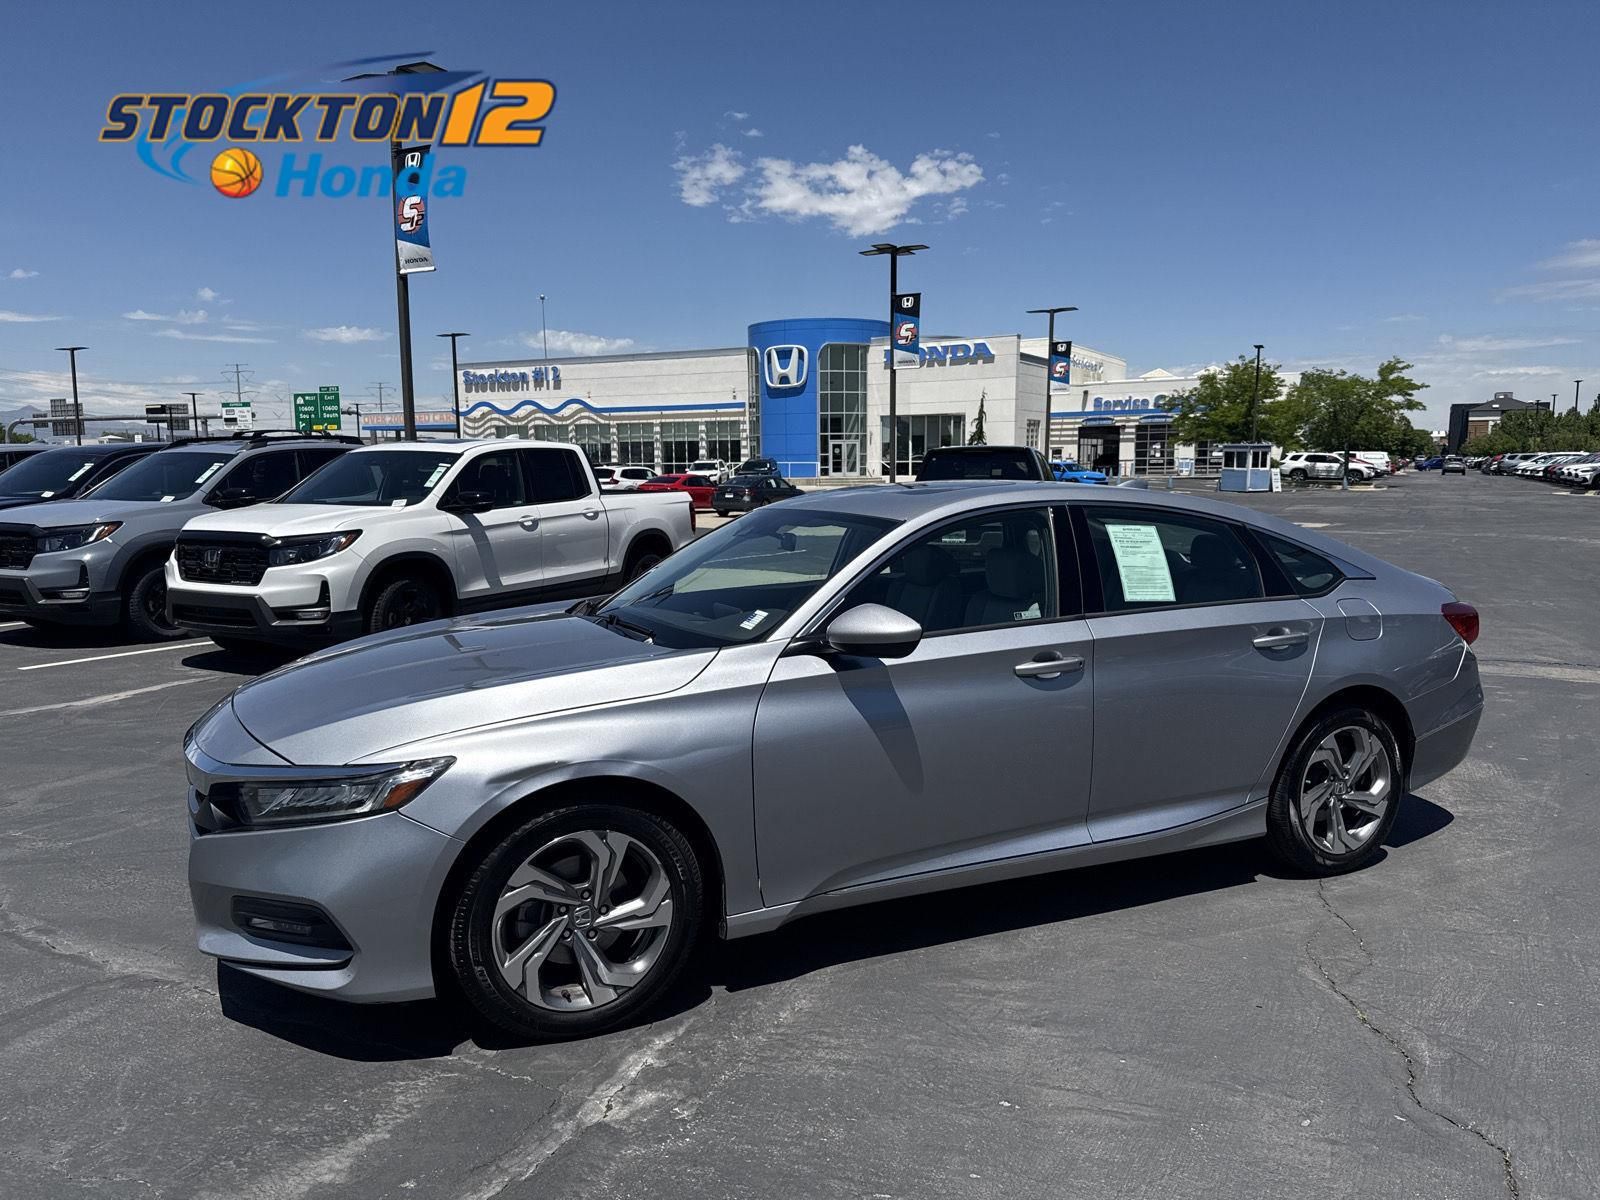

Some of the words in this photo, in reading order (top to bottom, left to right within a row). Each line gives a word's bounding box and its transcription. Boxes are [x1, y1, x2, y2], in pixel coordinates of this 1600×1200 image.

[404, 257, 428, 265] HONDA
[884, 341, 995, 363] NDA
[462, 369, 529, 385] Stockton
[531, 366, 561, 382] #12
[1093, 395, 1150, 410] Service
